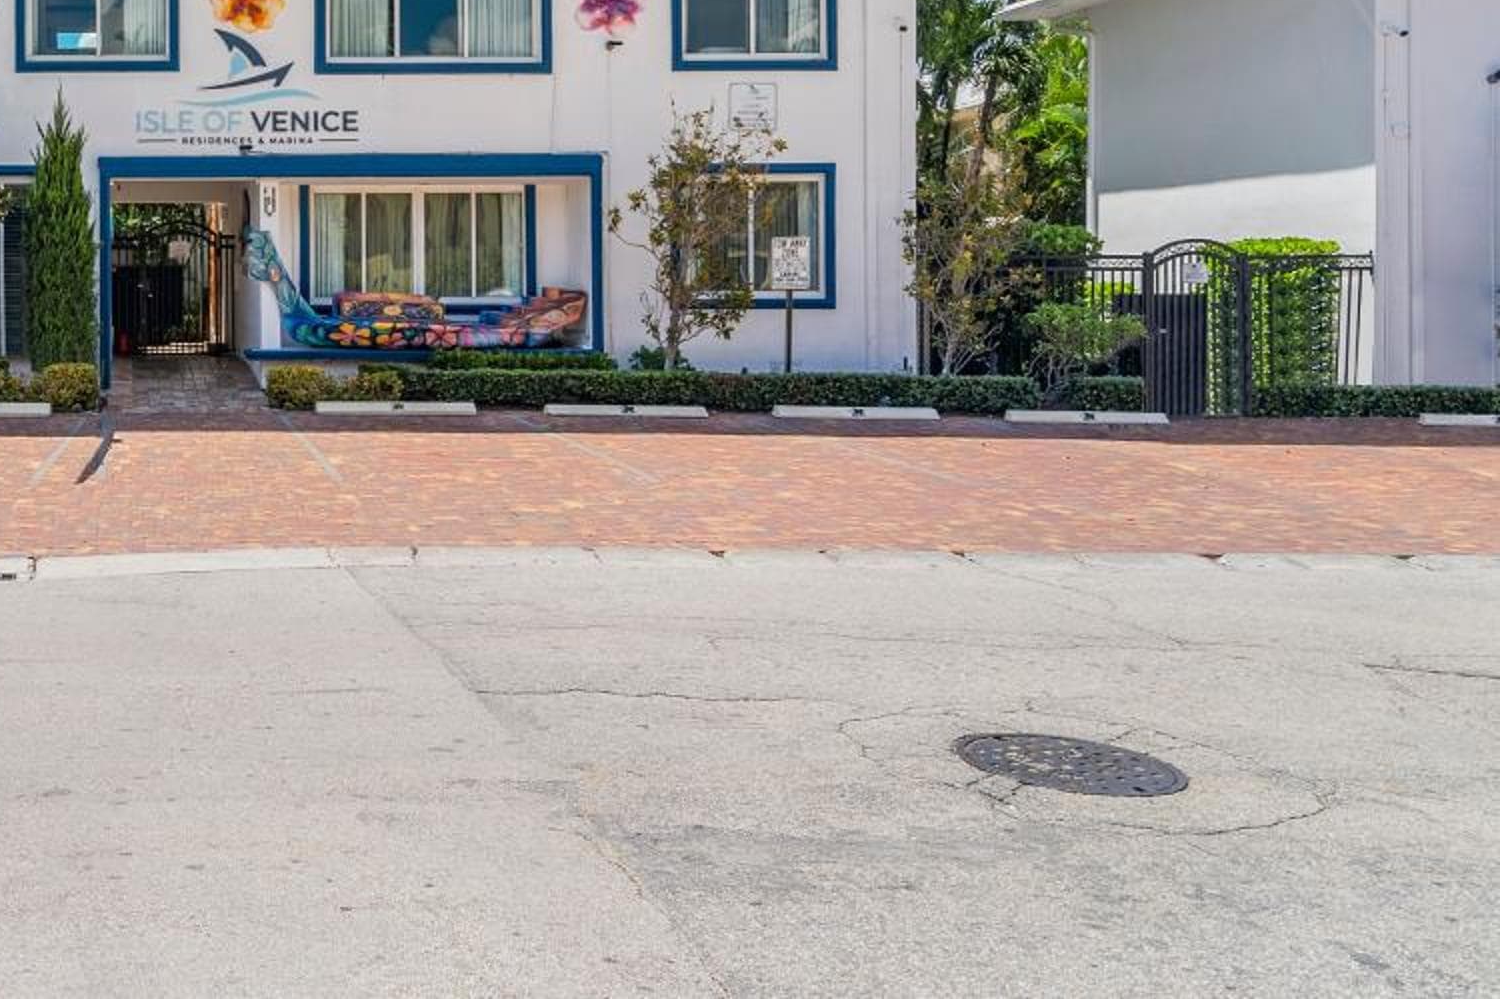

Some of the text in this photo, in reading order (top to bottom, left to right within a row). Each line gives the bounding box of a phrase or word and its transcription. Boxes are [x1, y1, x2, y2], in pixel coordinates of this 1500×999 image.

[135, 110, 359, 133] ISLE OF VENICE
[181, 136, 253, 145] RESIDENCES
[269, 136, 313, 144] MARINA
